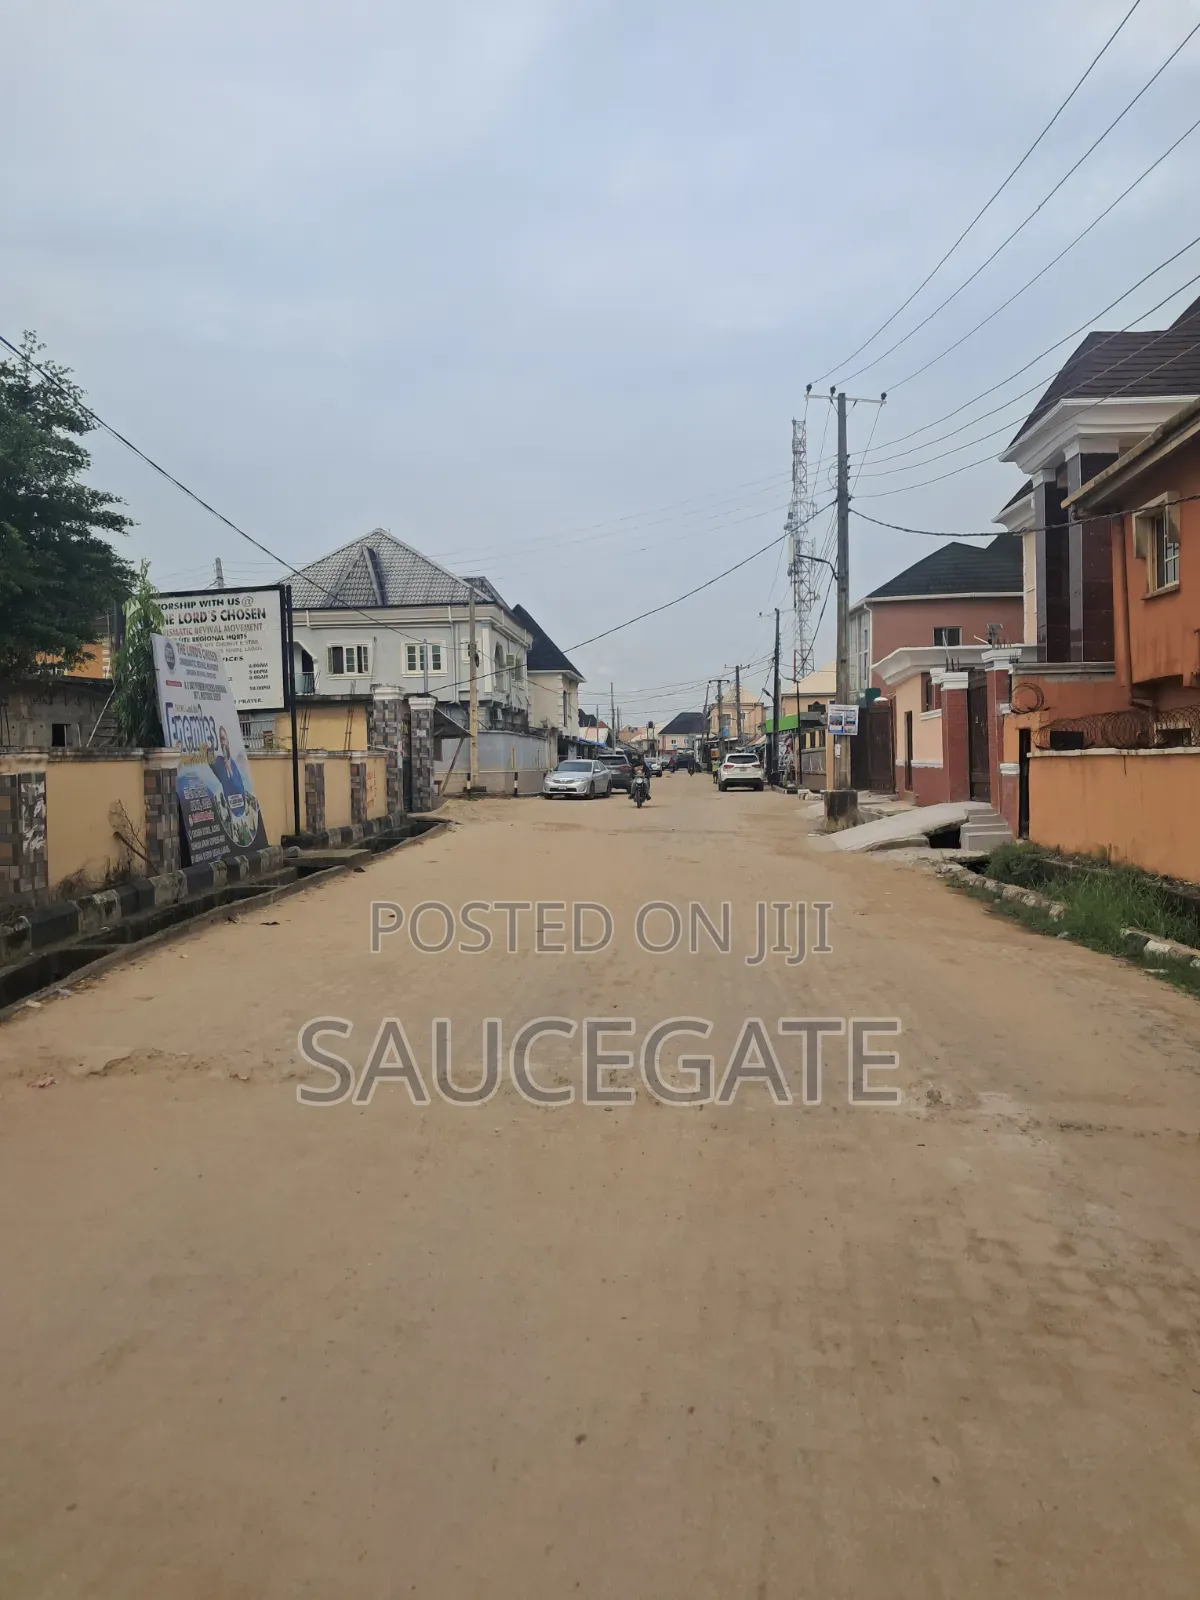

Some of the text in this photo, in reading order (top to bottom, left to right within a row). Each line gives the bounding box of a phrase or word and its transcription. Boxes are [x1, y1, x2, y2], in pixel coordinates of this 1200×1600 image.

[199, 599, 224, 608] WITH
[227, 598, 240, 606] US
[242, 595, 254, 607] @
[178, 610, 217, 625] LORD'S
[220, 607, 266, 622] CHOSEN
[194, 625, 222, 635] REVIVAL
[223, 622, 263, 632] MOVEMENT
[192, 635, 225, 643] REGIONAL
